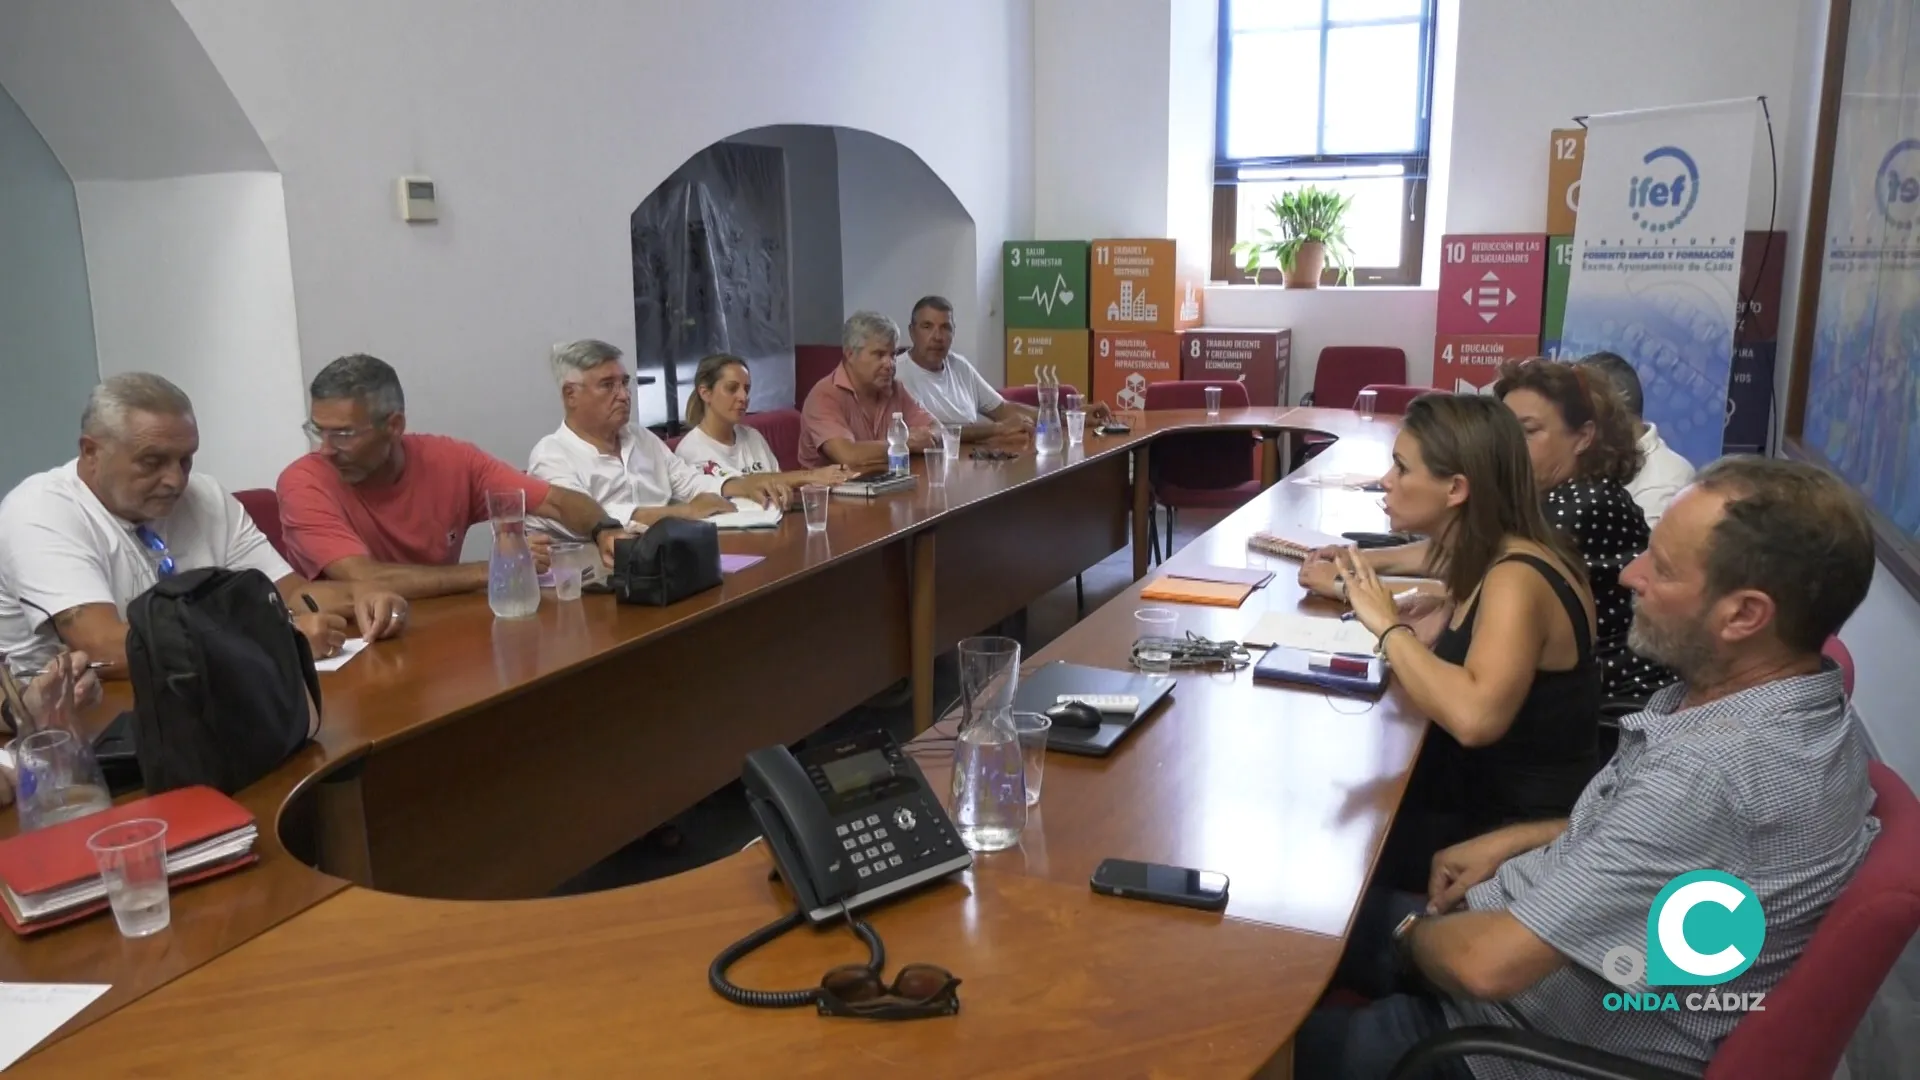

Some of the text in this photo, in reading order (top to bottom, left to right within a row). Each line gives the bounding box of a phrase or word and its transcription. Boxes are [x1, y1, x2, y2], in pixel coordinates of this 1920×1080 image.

[1555, 137, 1577, 160] 12
[1628, 175, 1686, 208] ifef
[1025, 247, 1045, 257] SALUD
[1471, 240, 1541, 252] REDUCCIÓN DE LAS
[1011, 247, 1021, 267] 3
[1095, 246, 1109, 265] 11
[1445, 241, 1466, 264] 10
[1471, 253, 1529, 264] DESIGUALDADES
[1583, 249, 1735, 260] FOMENTO EMPLEO Y FORMACIÓN
[1031, 257, 1063, 268] BIENESTAR
[1617, 261, 1685, 274] Ayuntamiento
[1013, 336, 1023, 356] 2
[1100, 338, 1110, 358] 9
[1190, 338, 1201, 359] 8
[1206, 339, 1261, 349] TRABAJO DECENTE
[1460, 342, 1504, 353] EDUCACIÓN
[1211, 350, 1253, 360] CRECIMIENTO
[1441, 343, 1454, 364] 4
[1204, 359, 1242, 370] ECONÓMICO
[1459, 355, 1503, 365] DE CALIDAD
